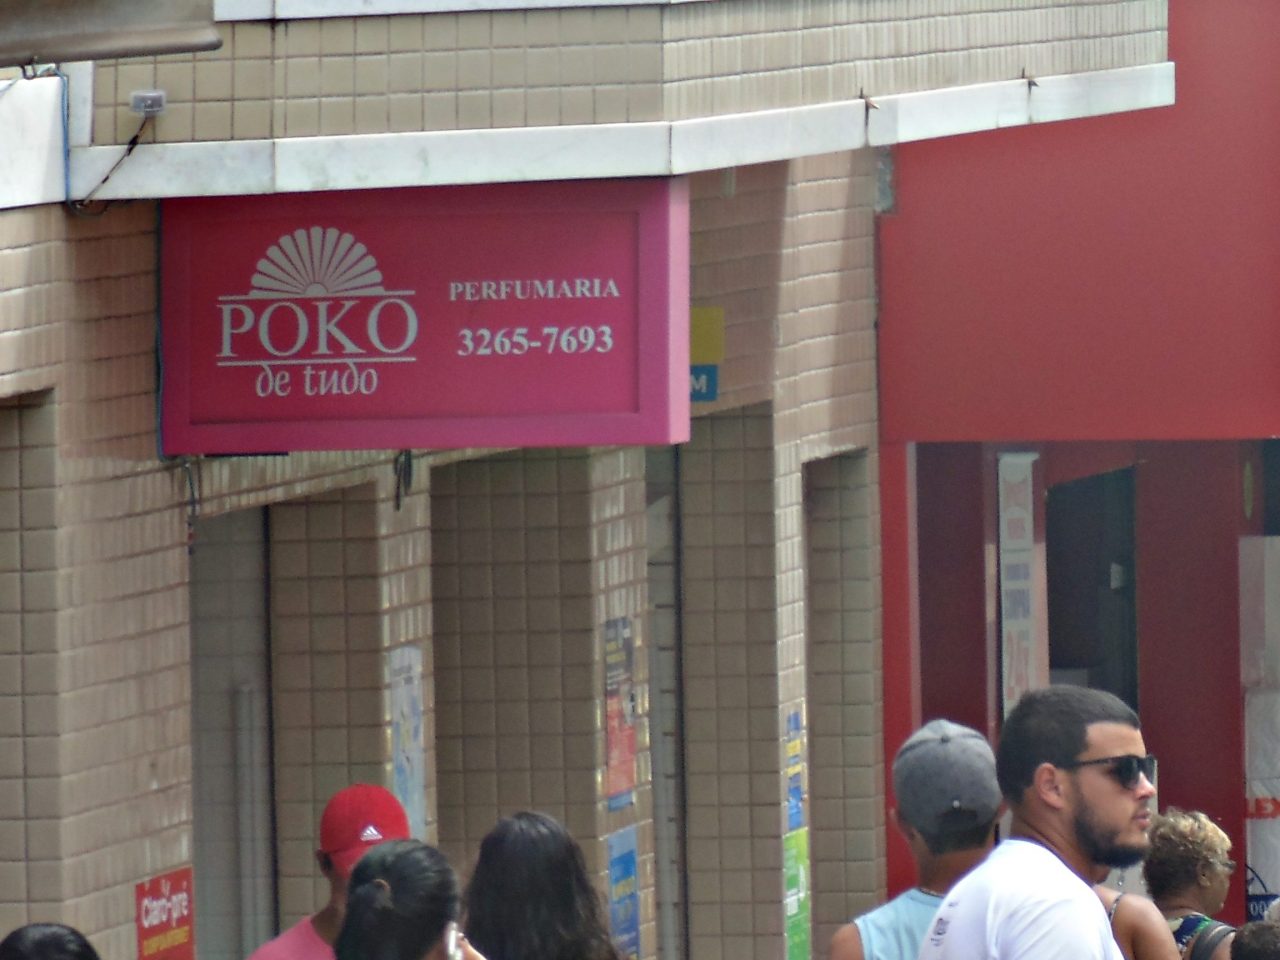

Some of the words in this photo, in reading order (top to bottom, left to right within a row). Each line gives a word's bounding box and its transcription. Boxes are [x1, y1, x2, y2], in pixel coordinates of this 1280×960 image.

[449, 278, 621, 301] PERFUMARIA
[215, 298, 419, 358] POKO
[457, 326, 614, 356] 3265-7693
[255, 362, 291, 397] de
[303, 360, 379, 395] tudo
